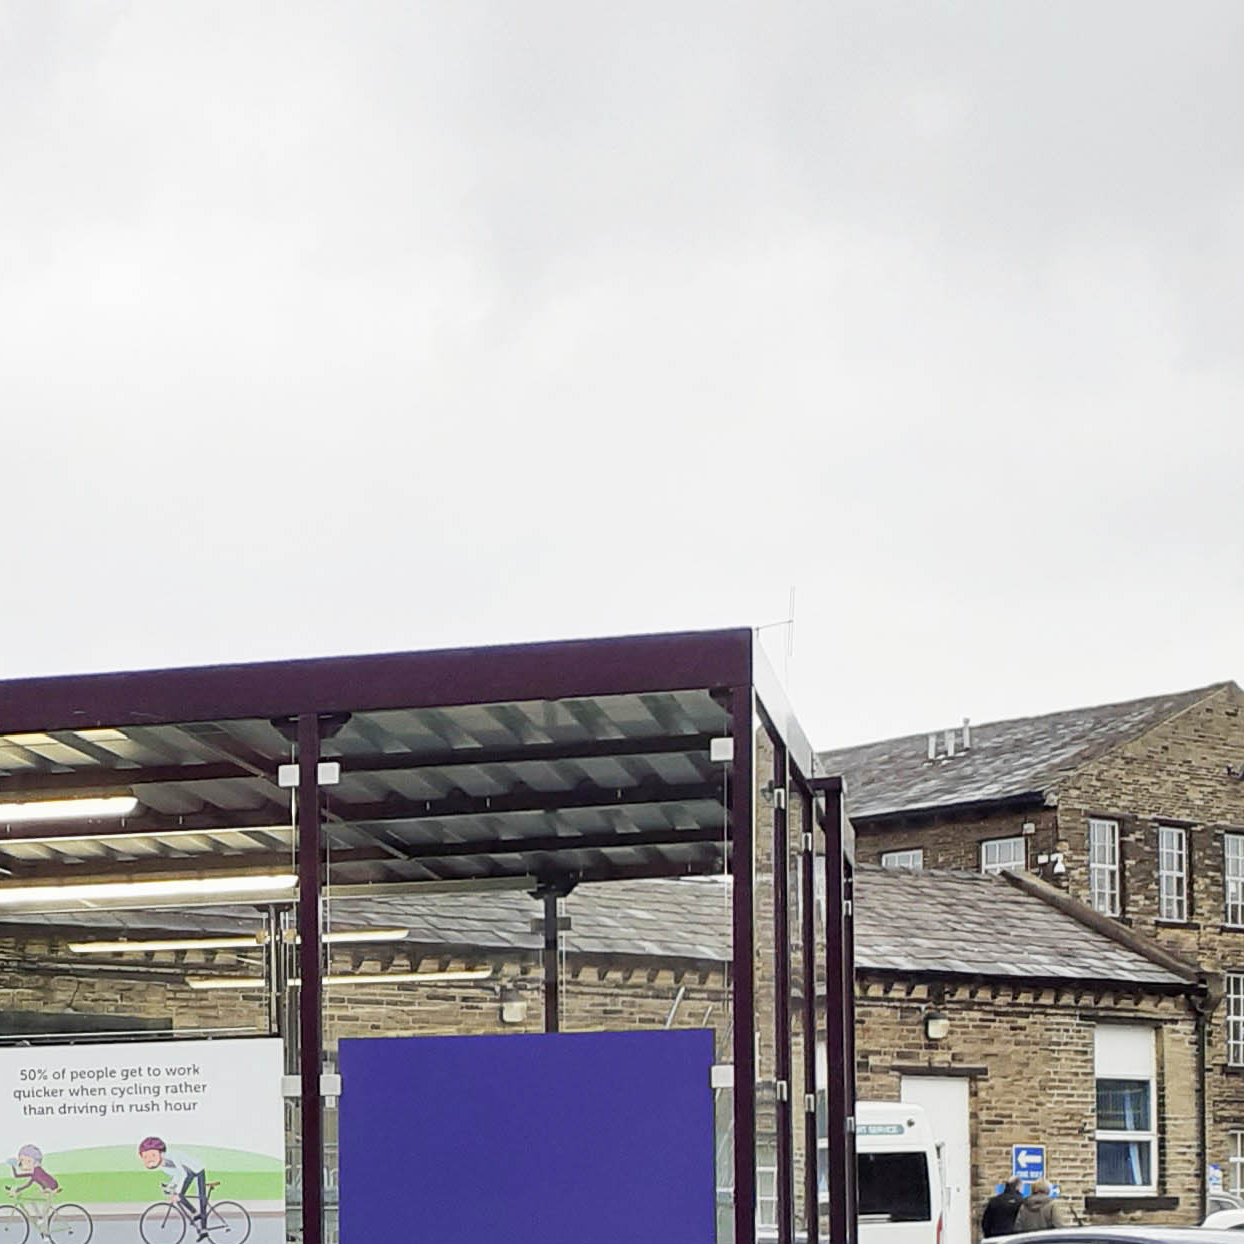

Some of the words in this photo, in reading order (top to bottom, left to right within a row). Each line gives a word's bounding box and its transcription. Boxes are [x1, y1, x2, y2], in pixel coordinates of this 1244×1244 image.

[20, 1068, 48, 1081] 50%
[52, 1067, 67, 1080] of
[70, 1066, 117, 1081] people
[120, 1066, 143, 1080] get
[147, 1066, 161, 1077] to
[165, 1063, 201, 1076] work
[13, 1085, 64, 1101] quicker
[68, 1084, 107, 1097] when
[110, 1082, 161, 1098] cycling
[165, 1081, 207, 1094] rather
[23, 1103, 54, 1115] than
[58, 1102, 107, 1117] driving
[111, 1101, 125, 1113] in
[129, 1101, 160, 1113] rush
[164, 1100, 198, 1112] hour
